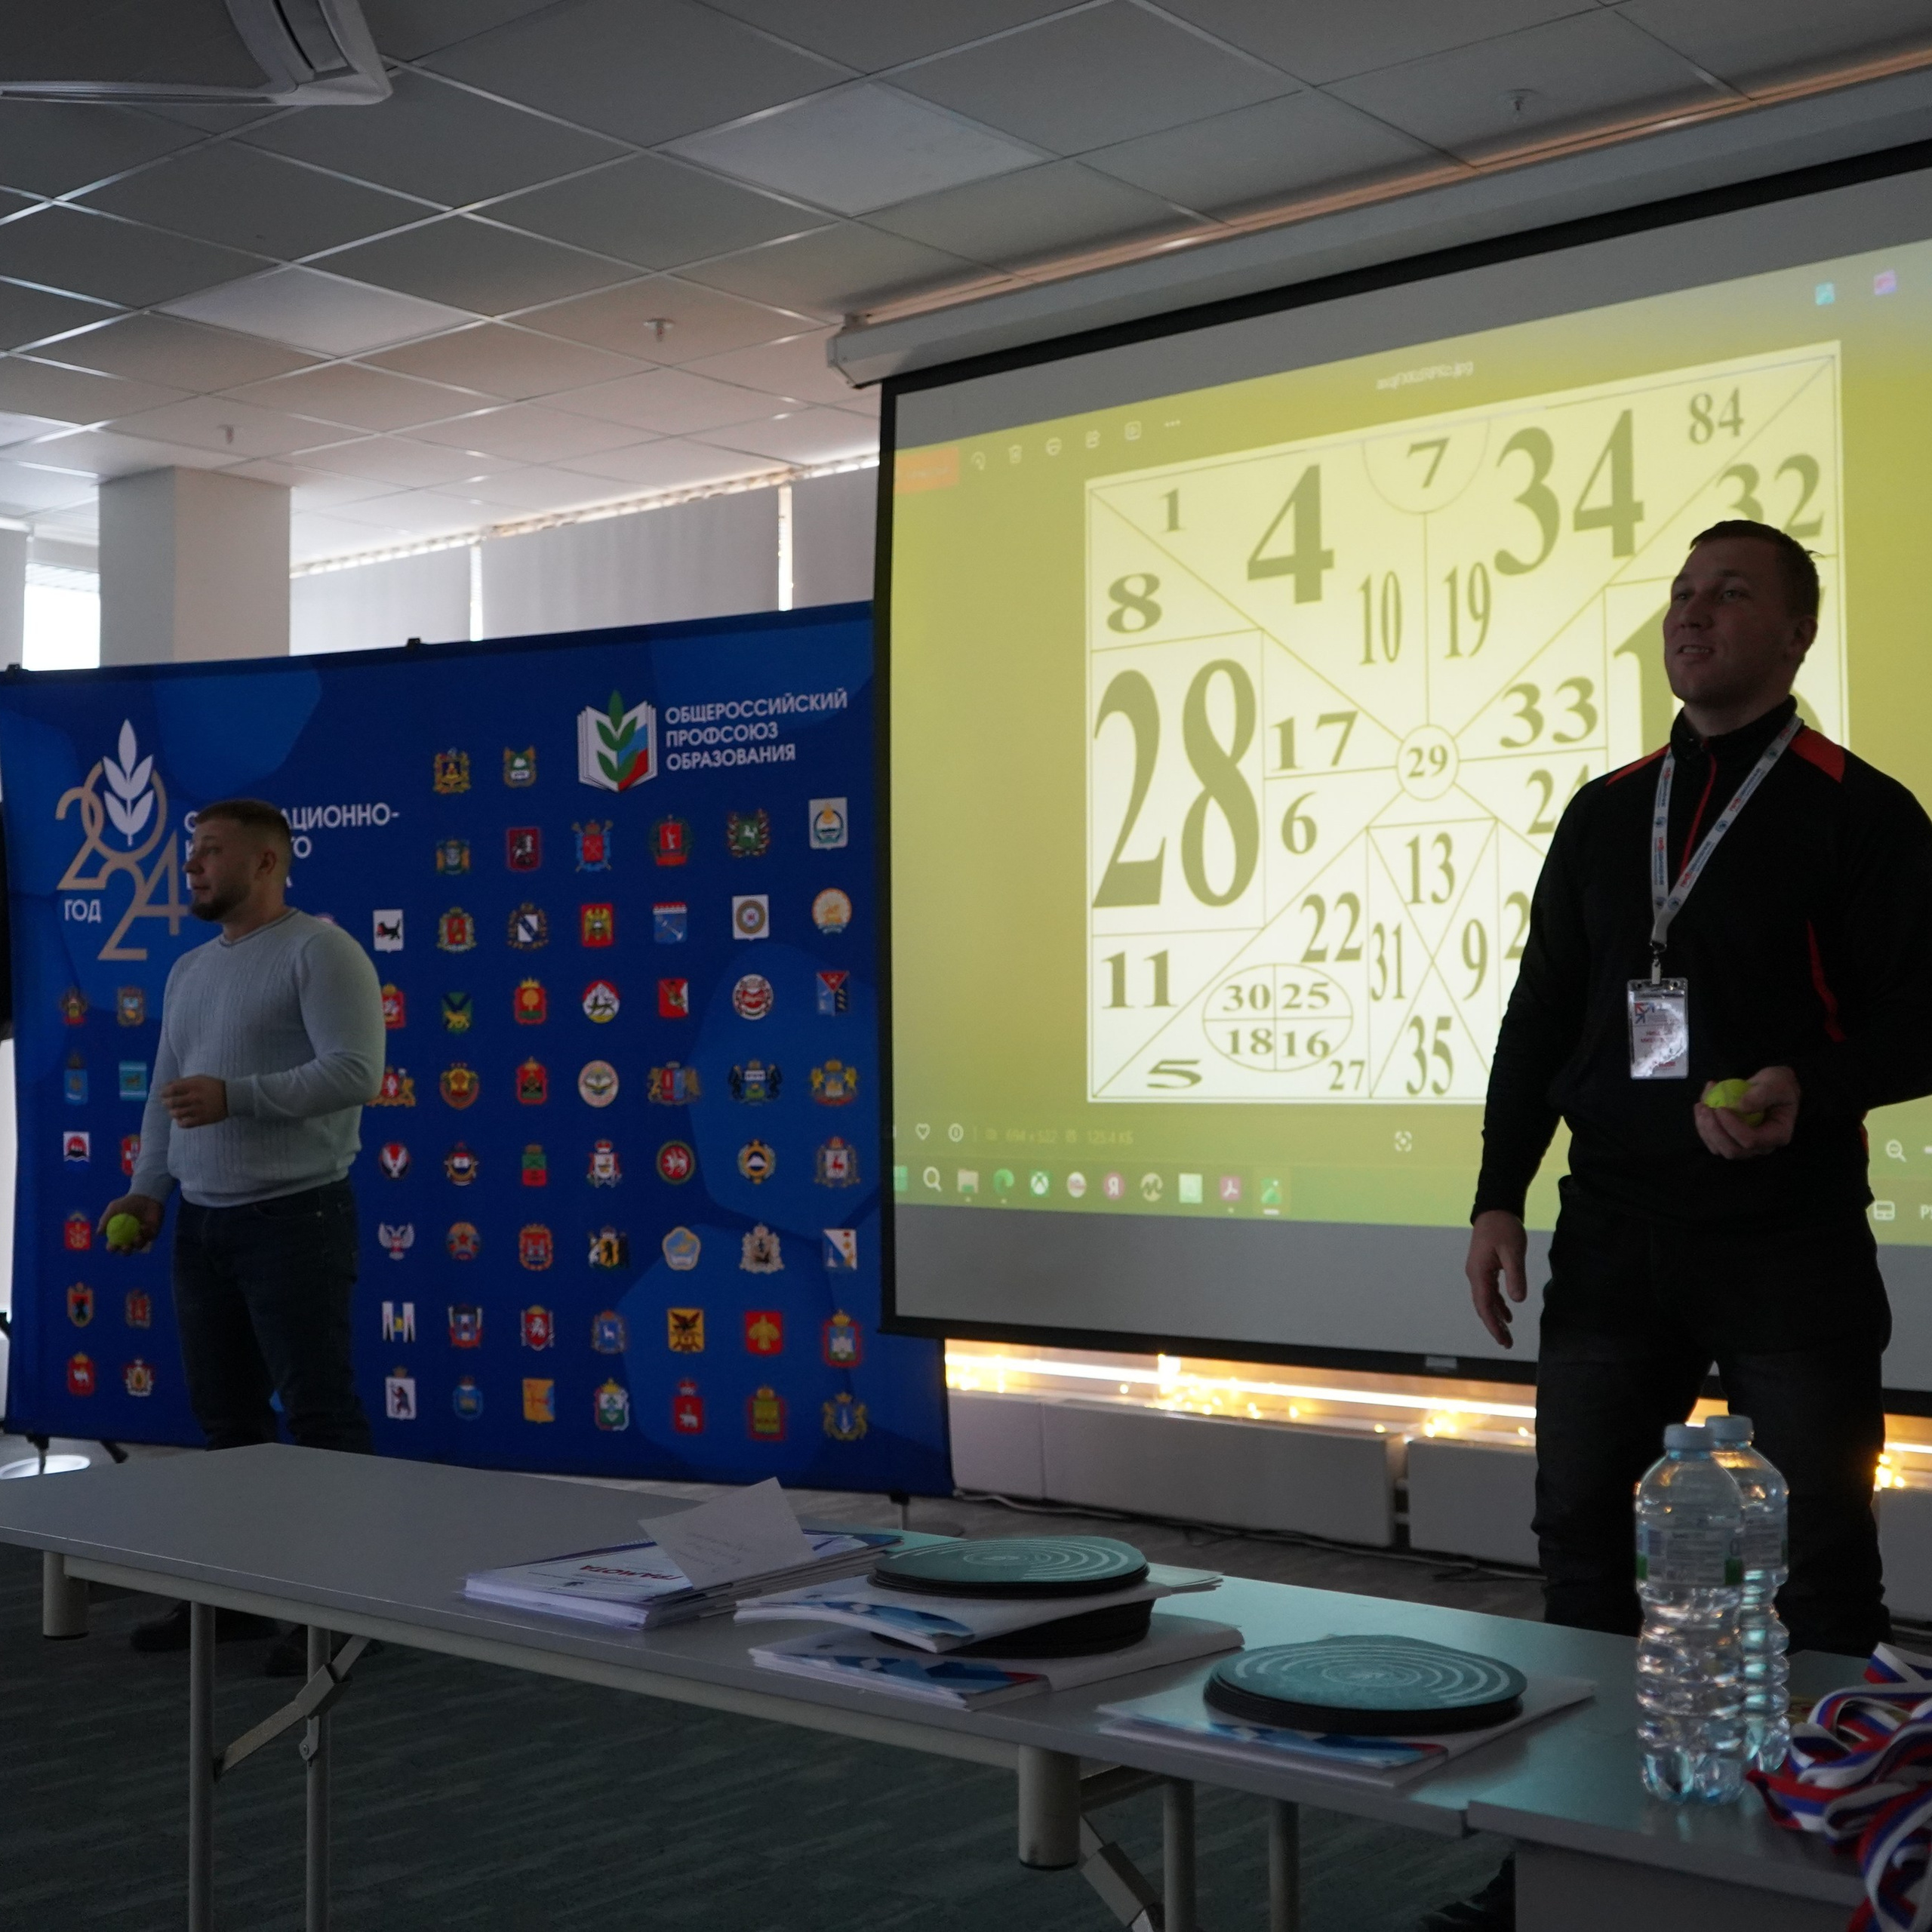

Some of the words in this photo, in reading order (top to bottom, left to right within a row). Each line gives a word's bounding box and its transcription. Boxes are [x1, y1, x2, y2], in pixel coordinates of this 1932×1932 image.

[1688, 387, 1745, 446] 84
[1407, 438, 1451, 489] 7
[1496, 408, 1644, 577] 34
[1159, 488, 1186, 533] 1
[1247, 464, 1334, 605] 4
[1106, 572, 1162, 634] 8
[1358, 571, 1403, 666] 10
[1444, 561, 1492, 660] 19
[666, 688, 848, 725] ОБЩЕРОССИЙСКИЙ
[666, 721, 779, 749] ПРОФСОЮЗ
[1500, 676, 1598, 748] 33
[666, 743, 796, 772] ОБРАЗОВАНИЯ
[1271, 712, 1360, 772] 17
[1406, 744, 1448, 777] 29
[1093, 658, 1260, 909] 28
[1281, 791, 1318, 855] 6
[1404, 831, 1456, 905] 13
[63, 899, 102, 924] ГОД
[1300, 891, 1363, 963] 22
[1101, 949, 1178, 1010] 11
[1371, 921, 1407, 1001] 31
[1461, 918, 1488, 1002] 9
[1222, 984, 1271, 1012] 30
[1281, 983, 1331, 1010] 25
[1226, 1028, 1273, 1056] 18
[1282, 1030, 1331, 1058] 16
[1406, 1015, 1454, 1096] 35
[1146, 1060, 1202, 1089] 5
[1328, 1060, 1365, 1092] 27
[579, 1564, 685, 1582] ГРАМОТА
